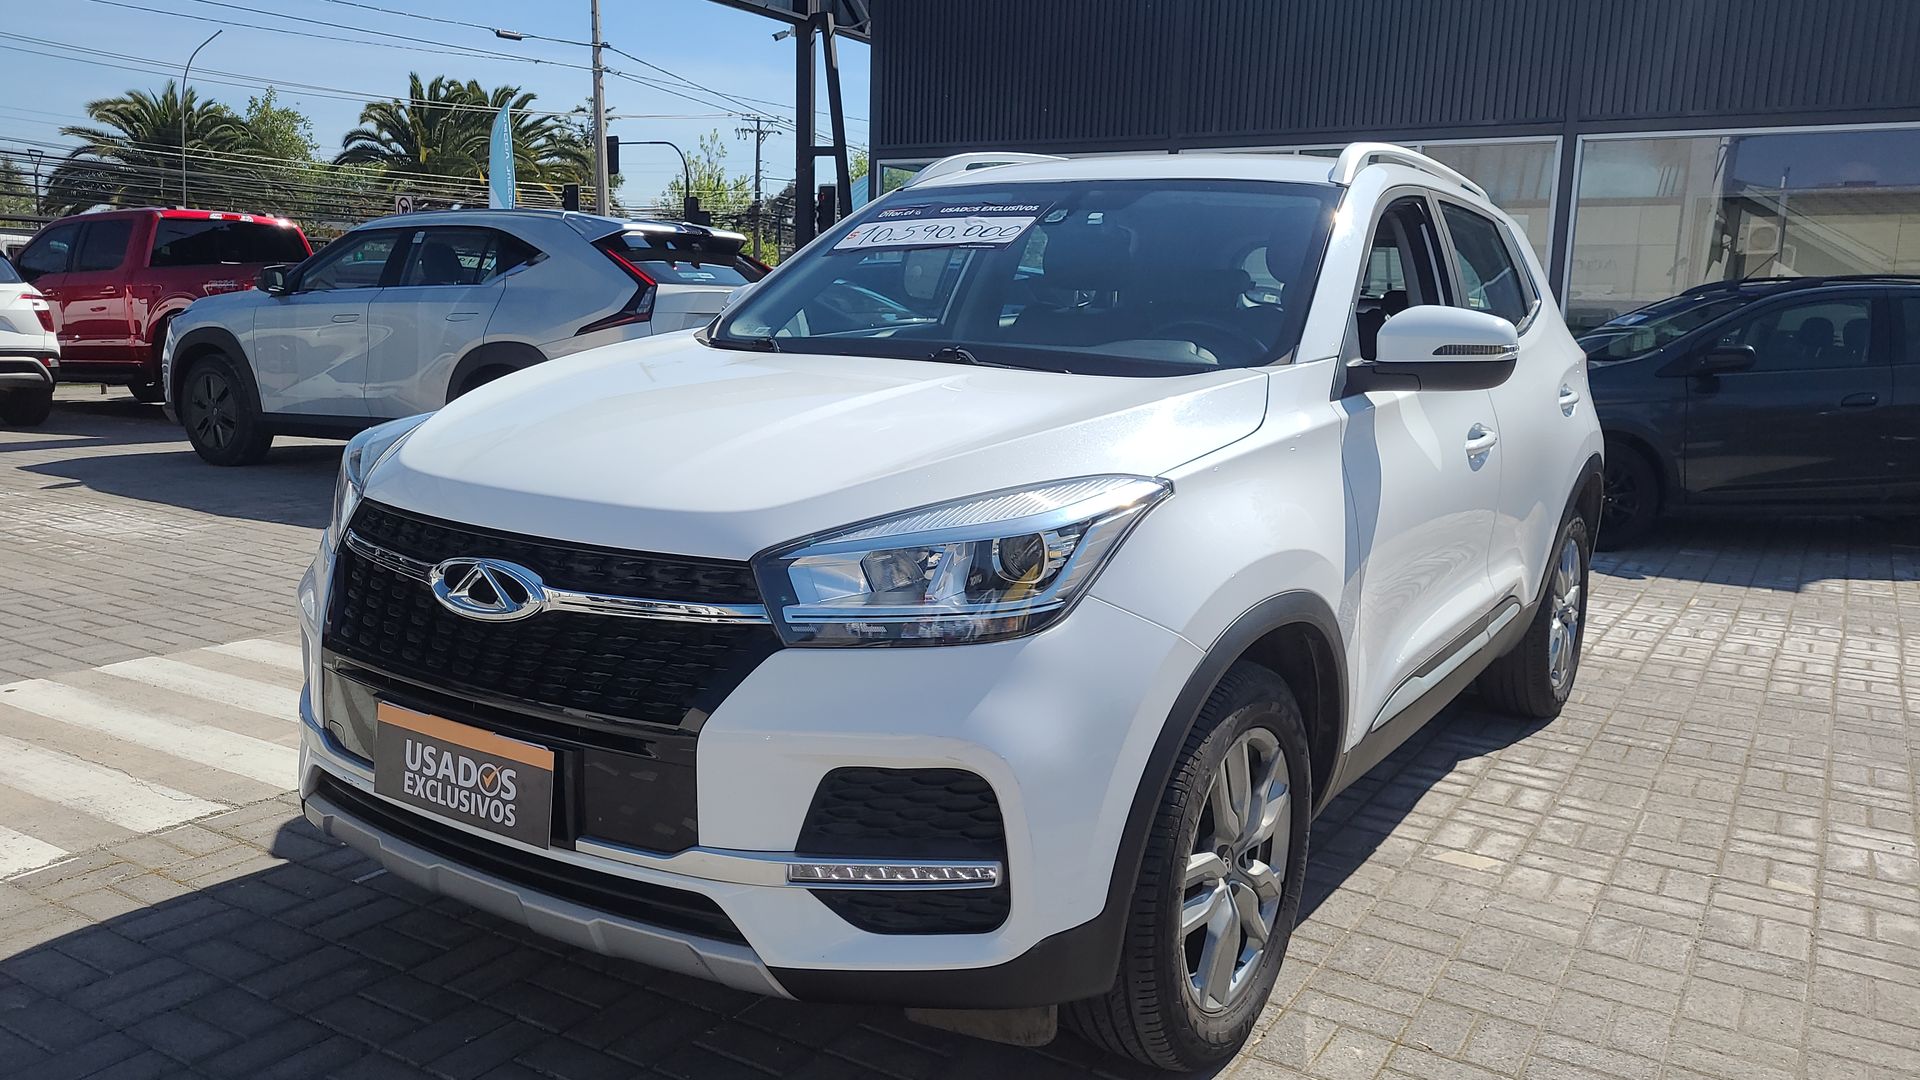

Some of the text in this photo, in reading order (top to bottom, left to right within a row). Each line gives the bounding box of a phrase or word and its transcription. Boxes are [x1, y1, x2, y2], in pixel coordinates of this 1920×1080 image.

[980, 204, 1040, 212] EXCLUSIVOS
[406, 738, 517, 801] USADOS
[403, 770, 517, 827] EXCLUSIVOS
